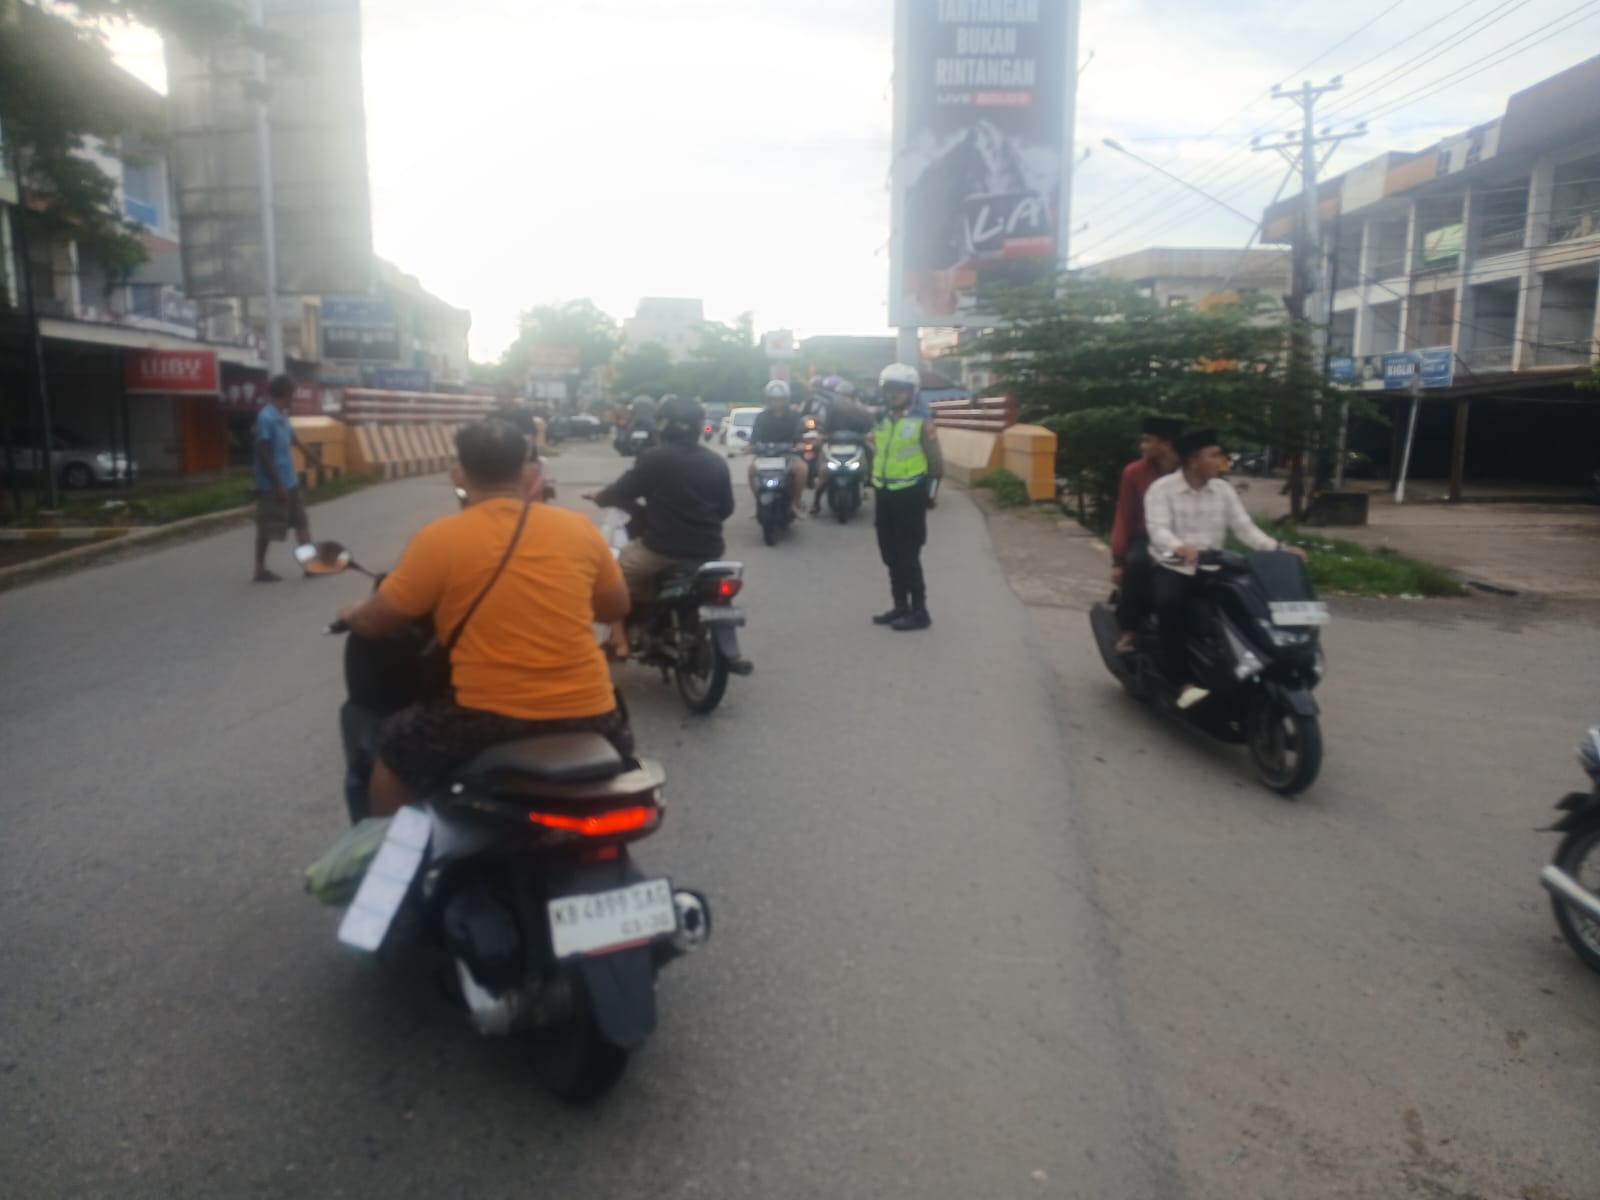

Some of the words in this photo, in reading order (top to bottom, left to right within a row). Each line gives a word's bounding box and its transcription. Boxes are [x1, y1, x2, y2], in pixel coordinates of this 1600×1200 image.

[937, 0, 1039, 22] TANTANGAN
[956, 27, 1016, 54] BUKAN
[935, 58, 1035, 85] RINTANGAN
